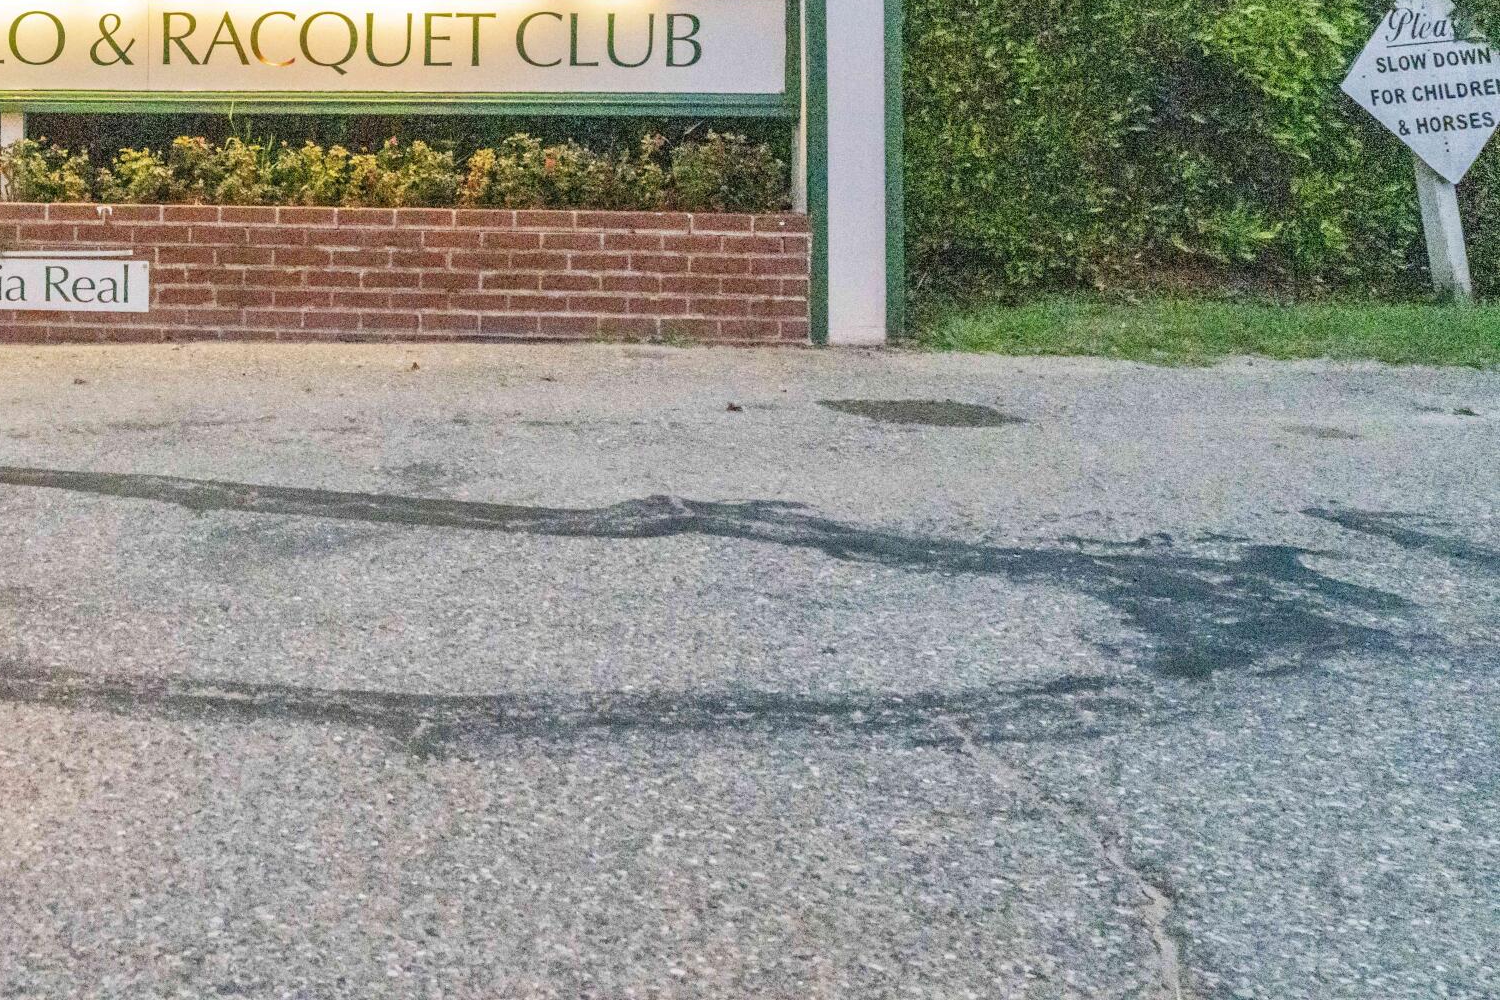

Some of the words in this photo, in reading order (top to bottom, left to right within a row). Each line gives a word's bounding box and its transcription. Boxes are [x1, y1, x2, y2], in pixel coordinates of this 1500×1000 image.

[89, 12, 135, 66] &
[161, 11, 497, 75] RACQUET
[515, 12, 703, 68] CLUB
[1377, 54, 1426, 74] SLOW
[1434, 47, 1491, 68] DOWN
[1370, 88, 1407, 106] FOR
[1398, 119, 1411, 136] &
[1417, 111, 1495, 134] HORSES
[45, 264, 130, 303] Real
